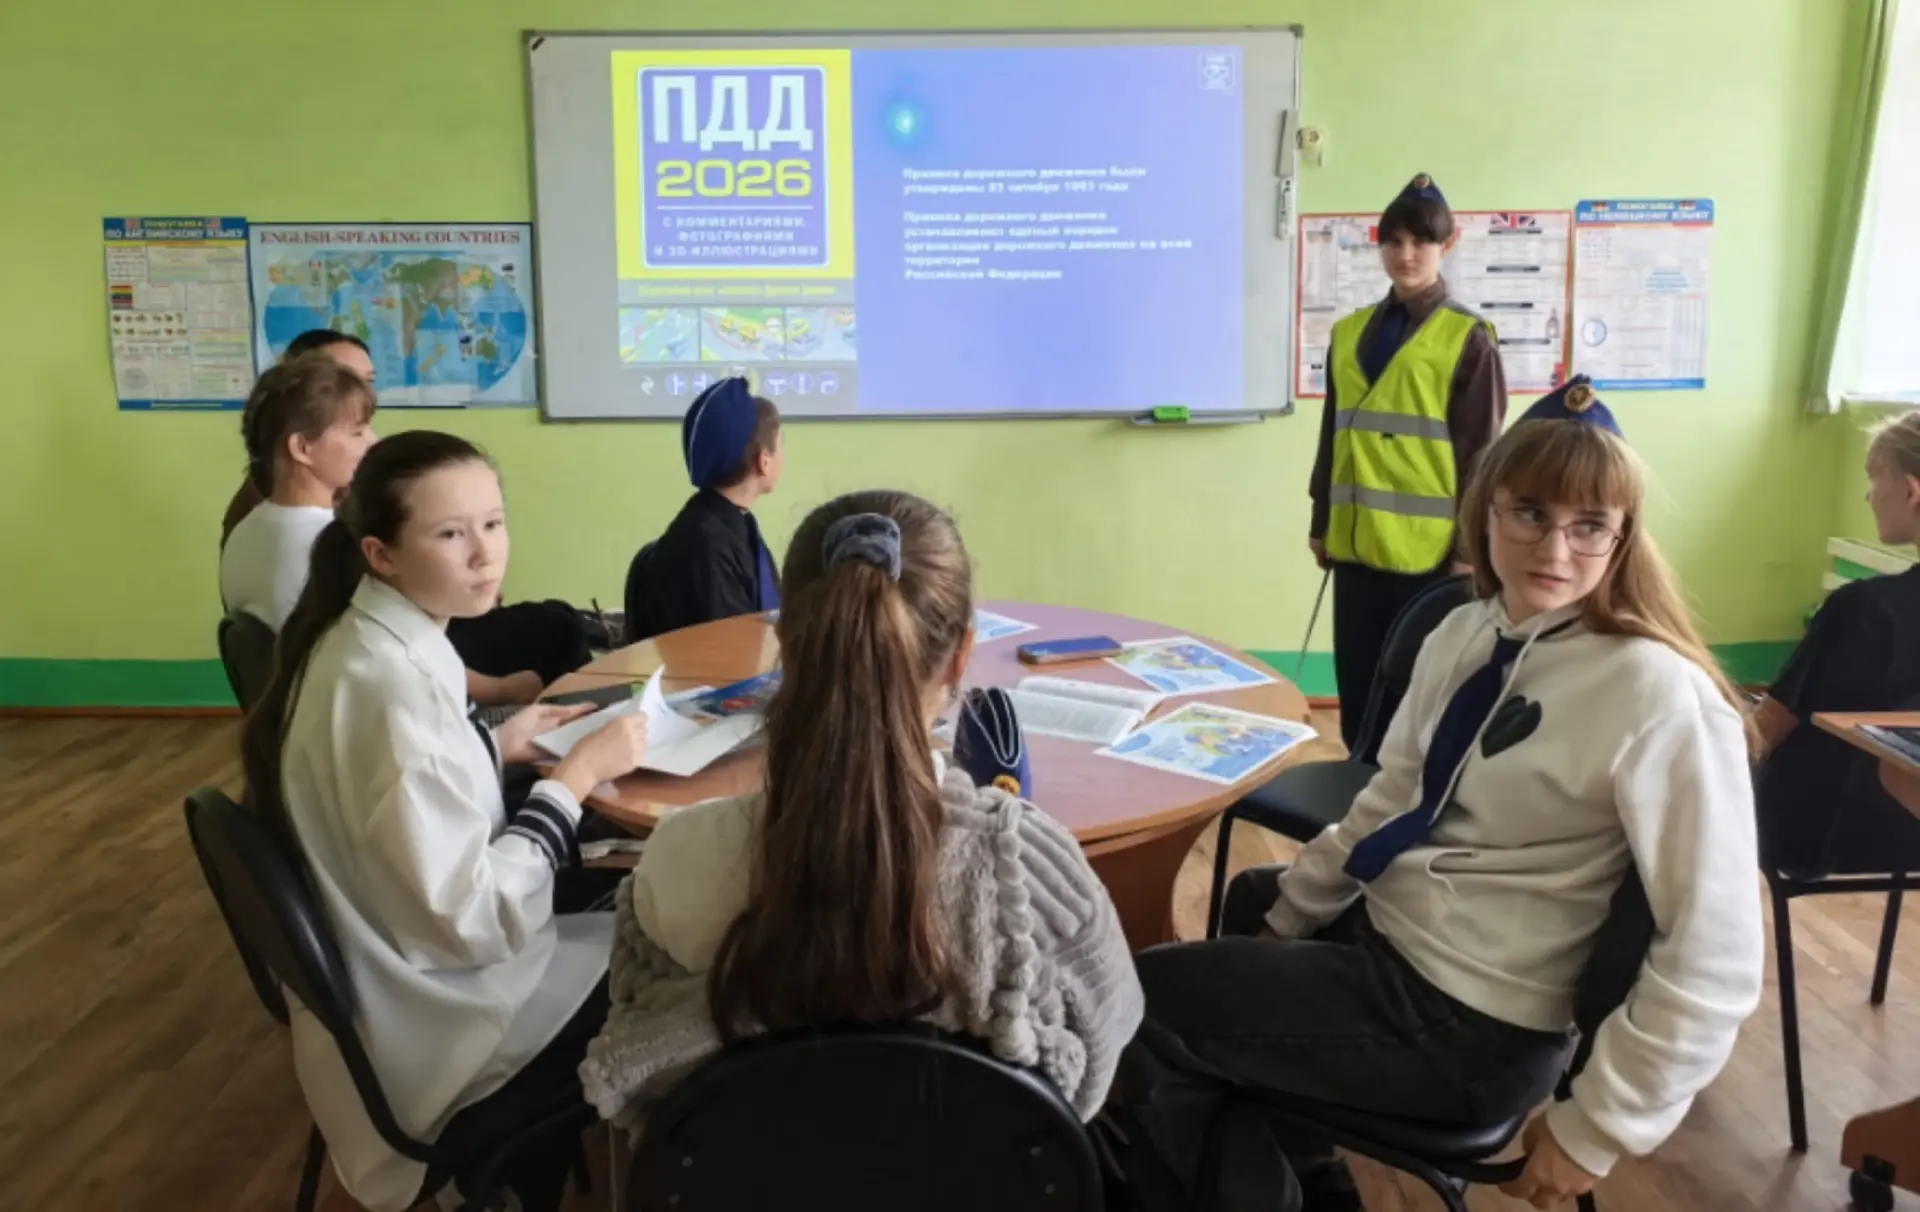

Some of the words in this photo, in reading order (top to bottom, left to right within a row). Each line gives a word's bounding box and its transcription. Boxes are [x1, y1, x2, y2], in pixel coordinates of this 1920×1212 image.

[653, 75, 813, 151] ПДД
[656, 159, 812, 197] 2026
[663, 217, 672, 228] С
[260, 230, 421, 245] ENGLISH-SPEAKING
[424, 230, 521, 245] COUNTRIES
[678, 231, 794, 242] ФОТОГРАФИЯМИ
[653, 246, 663, 257] И
[669, 245, 818, 257] 3D-ИЛЛЮСТРАЦИЯМИ
